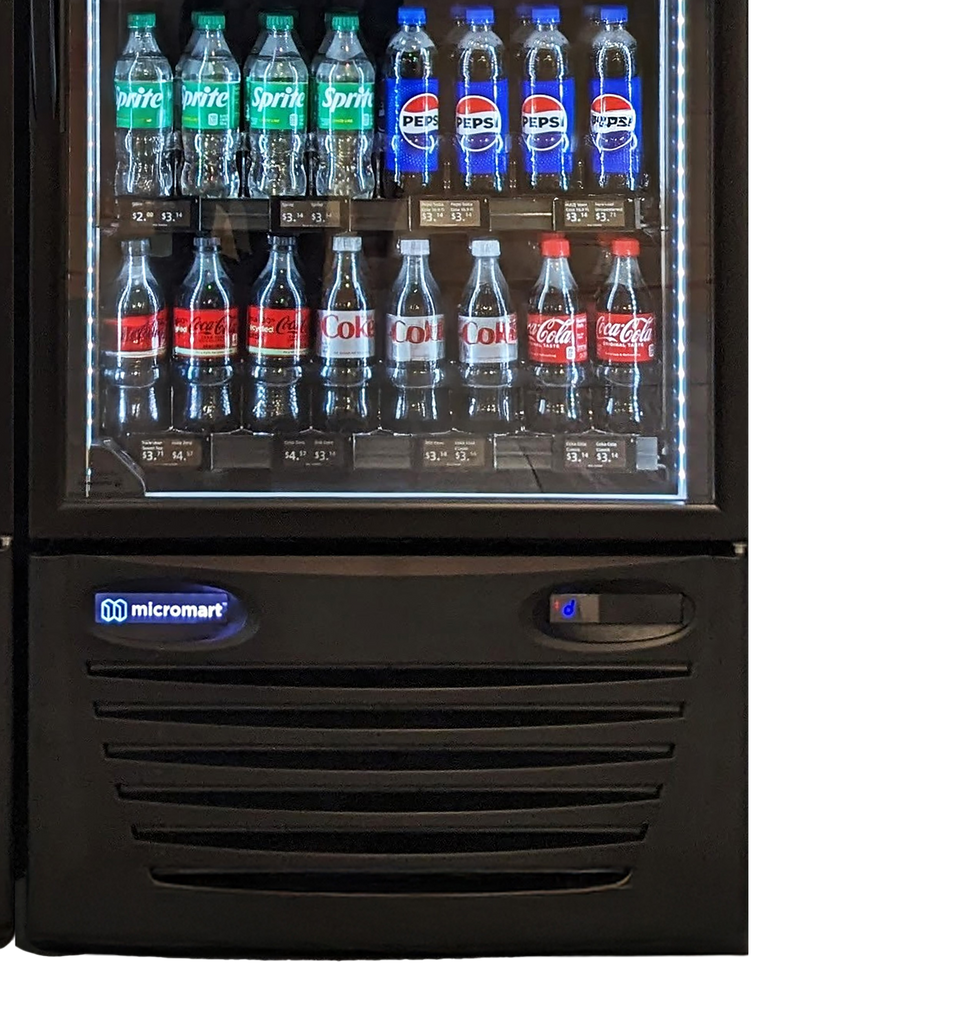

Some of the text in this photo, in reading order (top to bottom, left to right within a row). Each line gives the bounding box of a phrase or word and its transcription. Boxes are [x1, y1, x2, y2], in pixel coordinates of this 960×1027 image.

[251, 86, 305, 112] Sprite
[403, 115, 438, 127] PEPS
[456, 116, 499, 129] PEPSI
[523, 116, 565, 129] PEPSI
[596, 315, 654, 344] Coca-Cola
[131, 601, 222, 618] micromart
